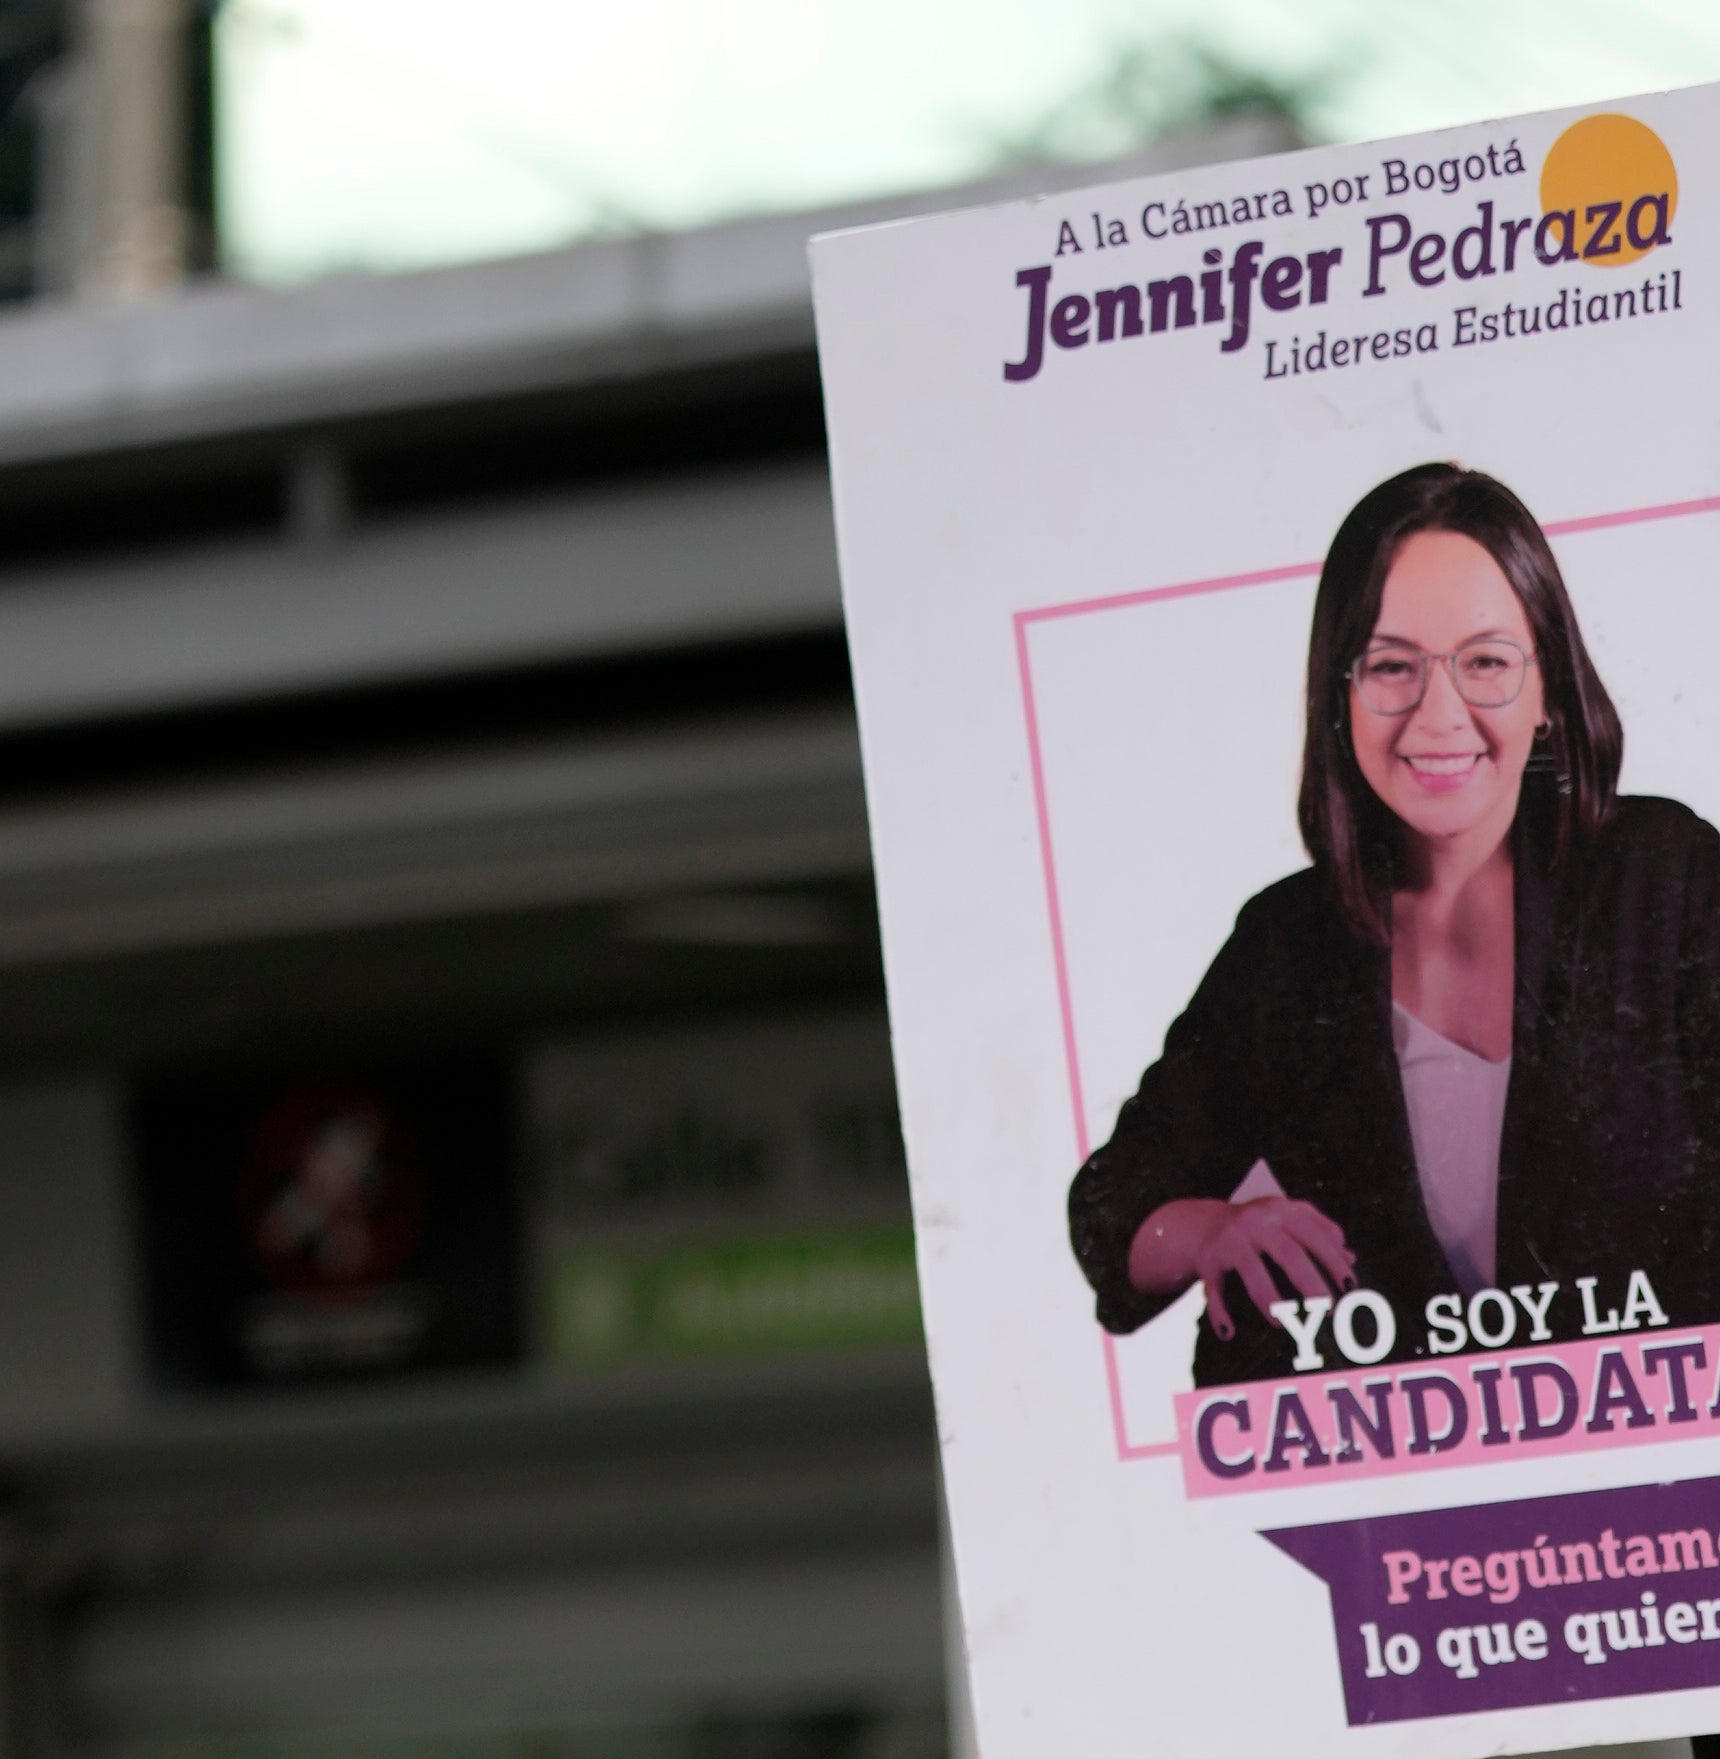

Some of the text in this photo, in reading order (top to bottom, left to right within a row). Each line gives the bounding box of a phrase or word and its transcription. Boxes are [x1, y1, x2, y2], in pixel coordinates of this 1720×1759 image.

[1054, 138, 1526, 256] A la Cámara por Bogotá
[1003, 189, 1674, 382] Jennifer Pedraza
[1264, 270, 1684, 379] Lideresa Estudiantil
[1269, 1270, 1669, 1372] YO SOY LA
[1359, 1622, 1421, 1679] lo
[1436, 1617, 1549, 1680] que
